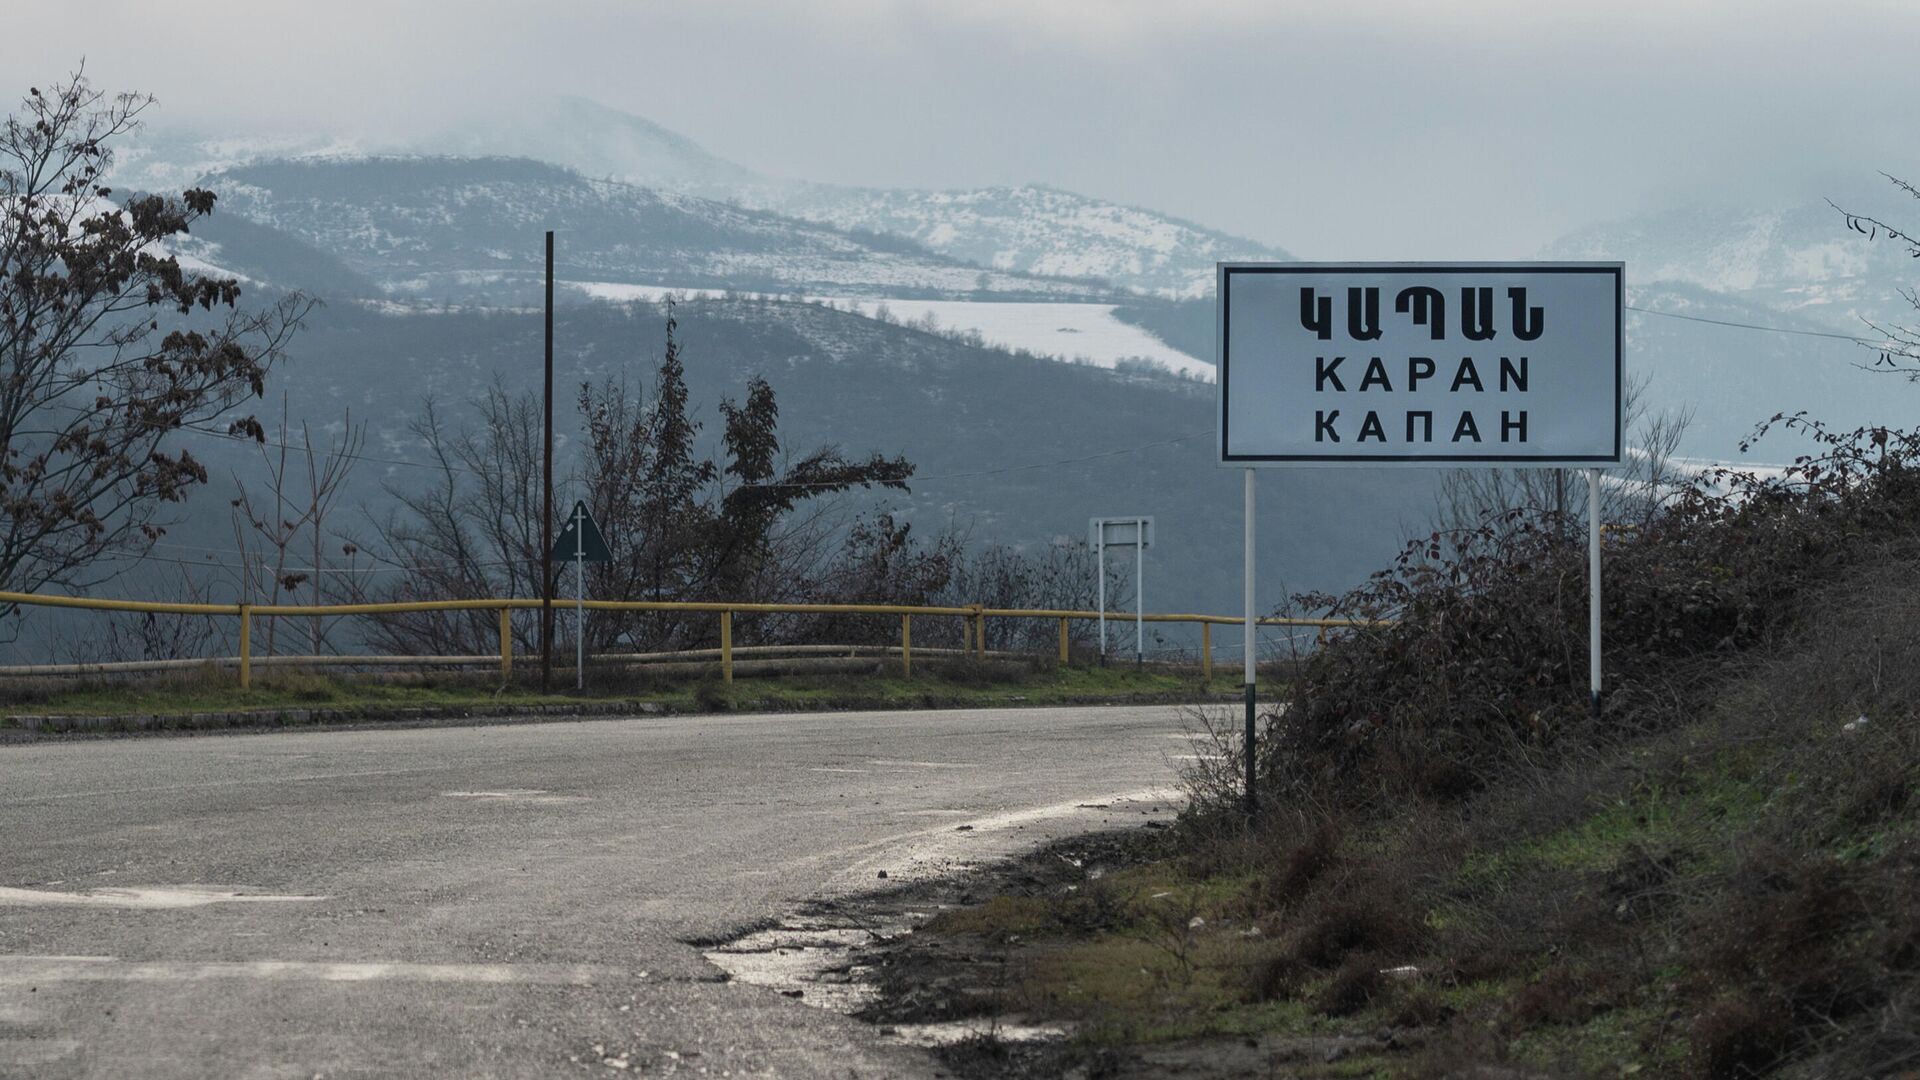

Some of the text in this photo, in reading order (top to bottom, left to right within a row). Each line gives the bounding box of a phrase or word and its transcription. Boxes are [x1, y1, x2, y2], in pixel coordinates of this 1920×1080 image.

[1300, 286, 1544, 341] ԿԱՊԱՆ
[1315, 357, 1529, 392] KAPAN
[1315, 410, 1529, 443] КАПАН
